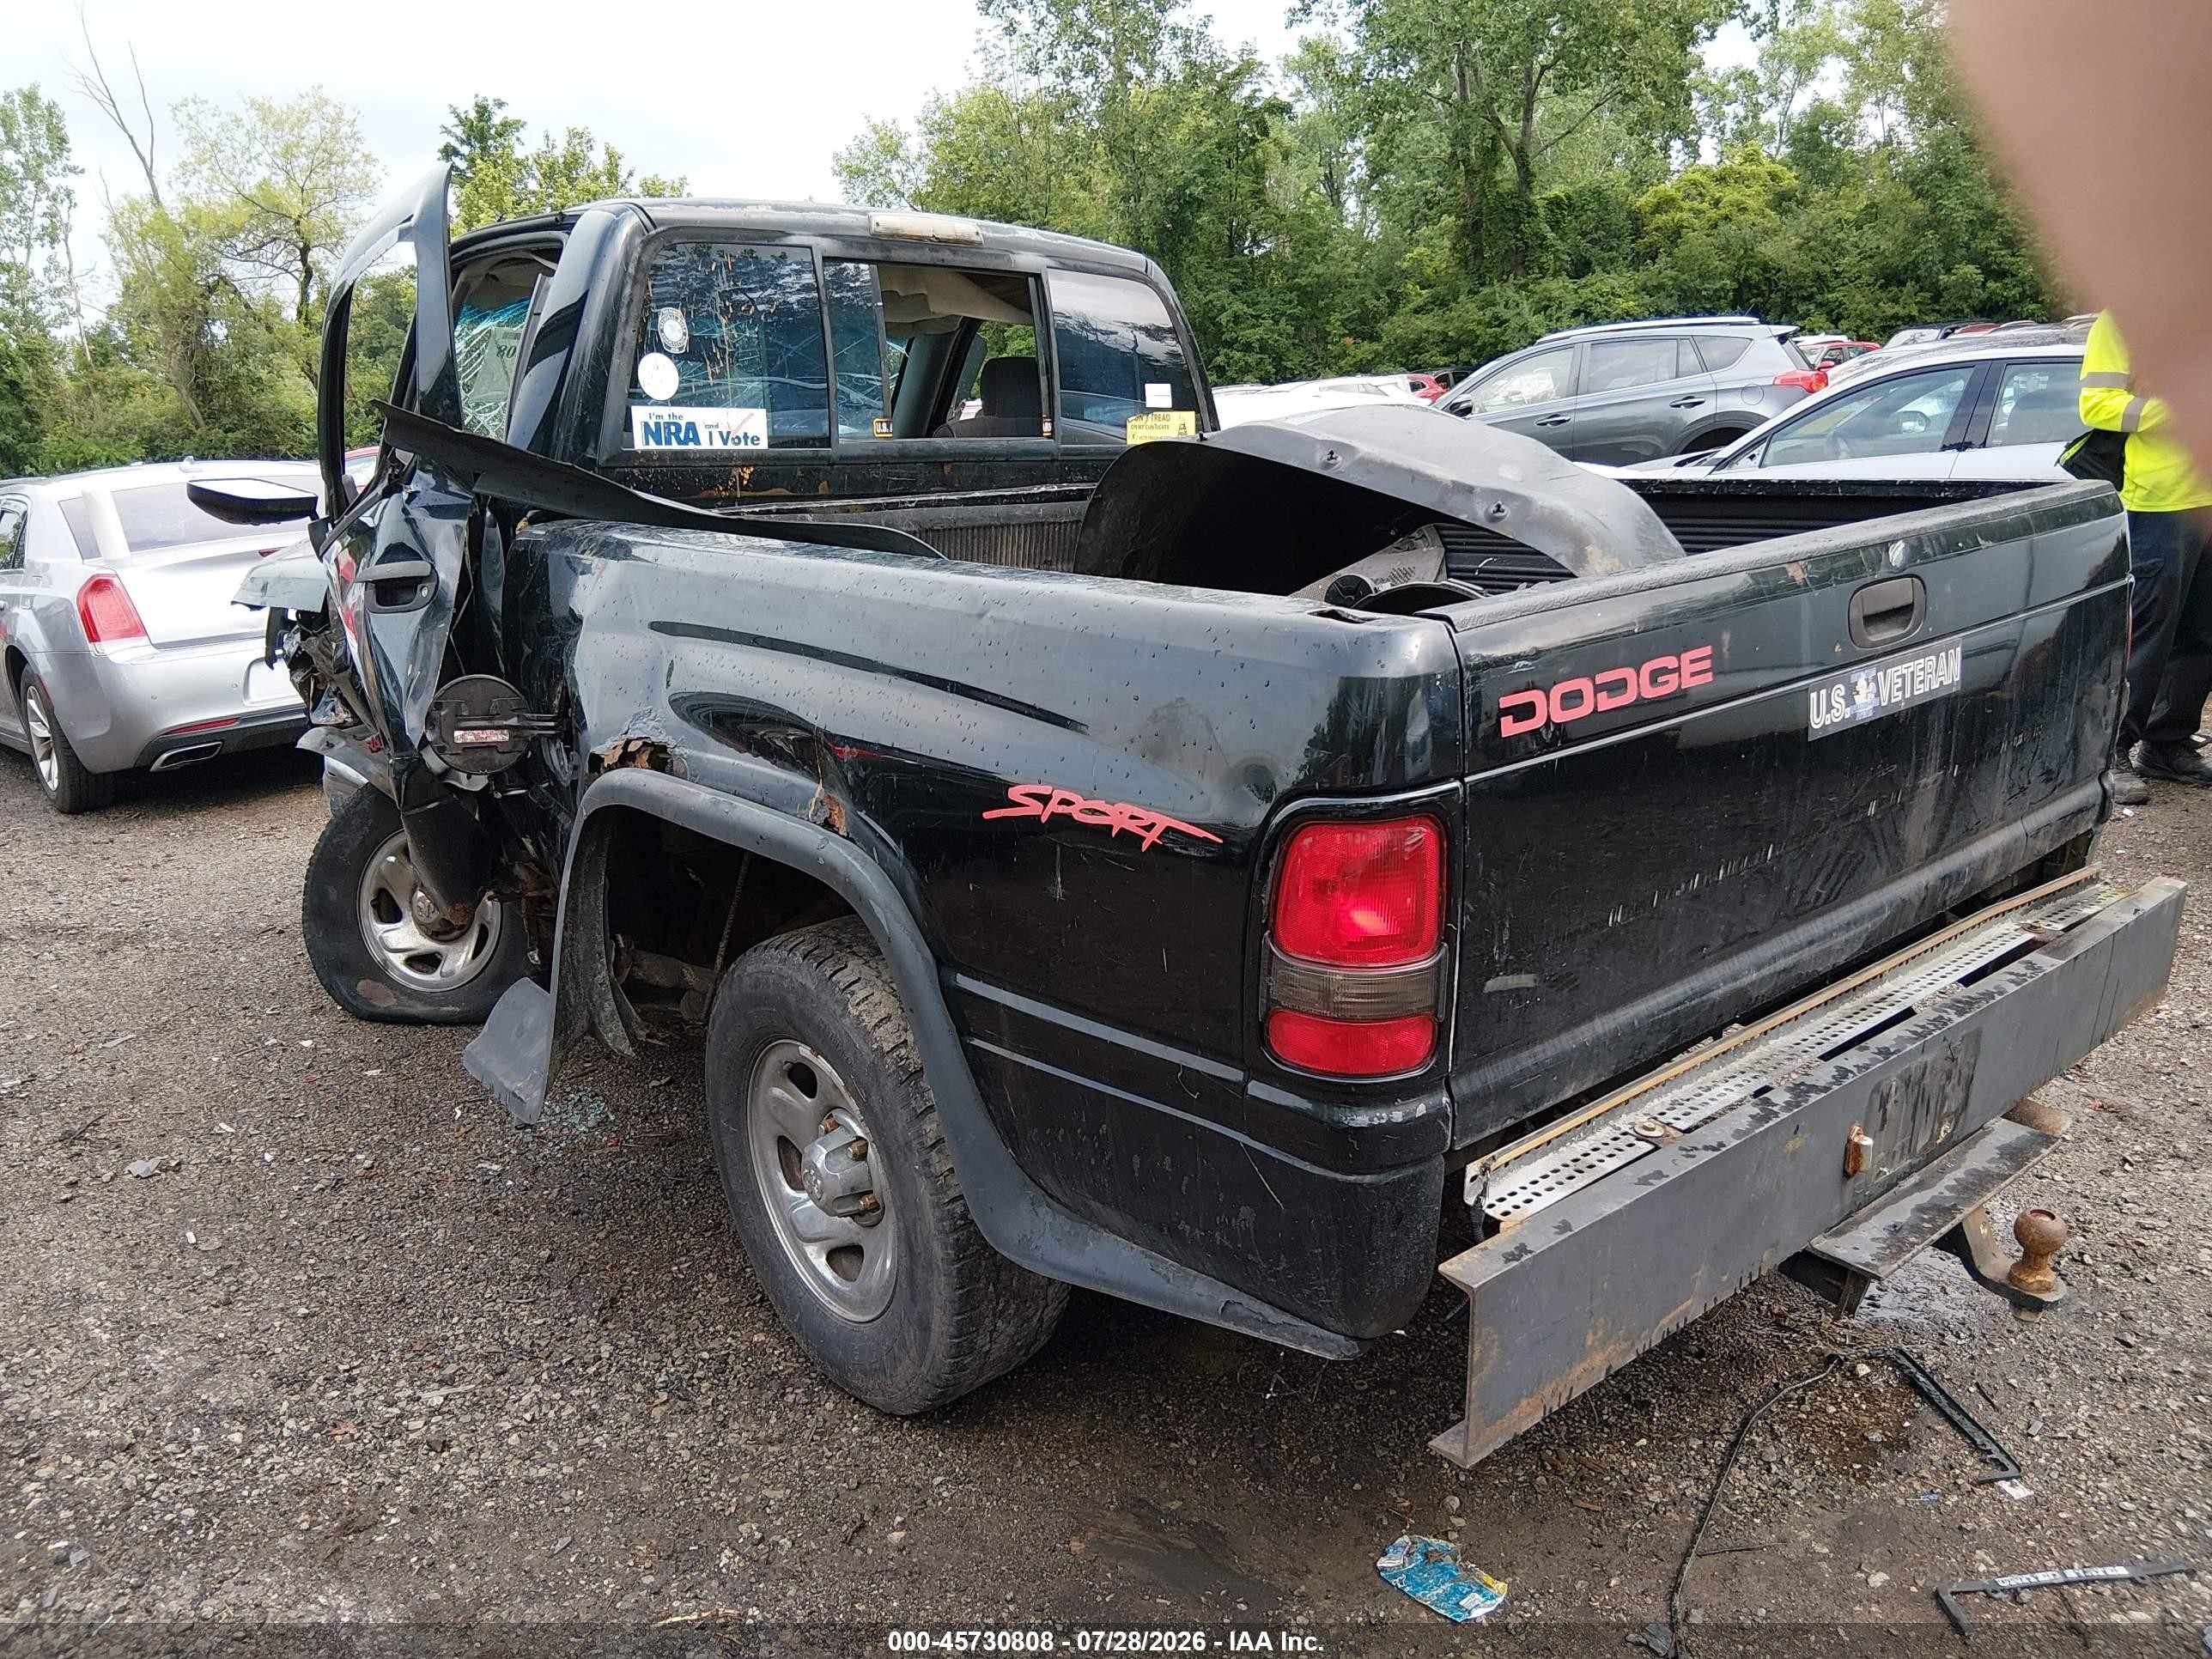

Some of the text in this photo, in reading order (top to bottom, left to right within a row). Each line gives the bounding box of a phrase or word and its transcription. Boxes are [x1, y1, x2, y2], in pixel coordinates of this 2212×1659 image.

[649, 412, 684, 421] I'm the
[641, 421, 702, 446] NRA
[876, 422, 889, 433] U.S.
[708, 430, 761, 446] I Vote
[1498, 645, 1714, 738] DODGE
[1809, 647, 1962, 729] U.S. VETERAN
[982, 783, 1224, 853] SPORT
[1995, 1571, 2061, 1587] UNITED
